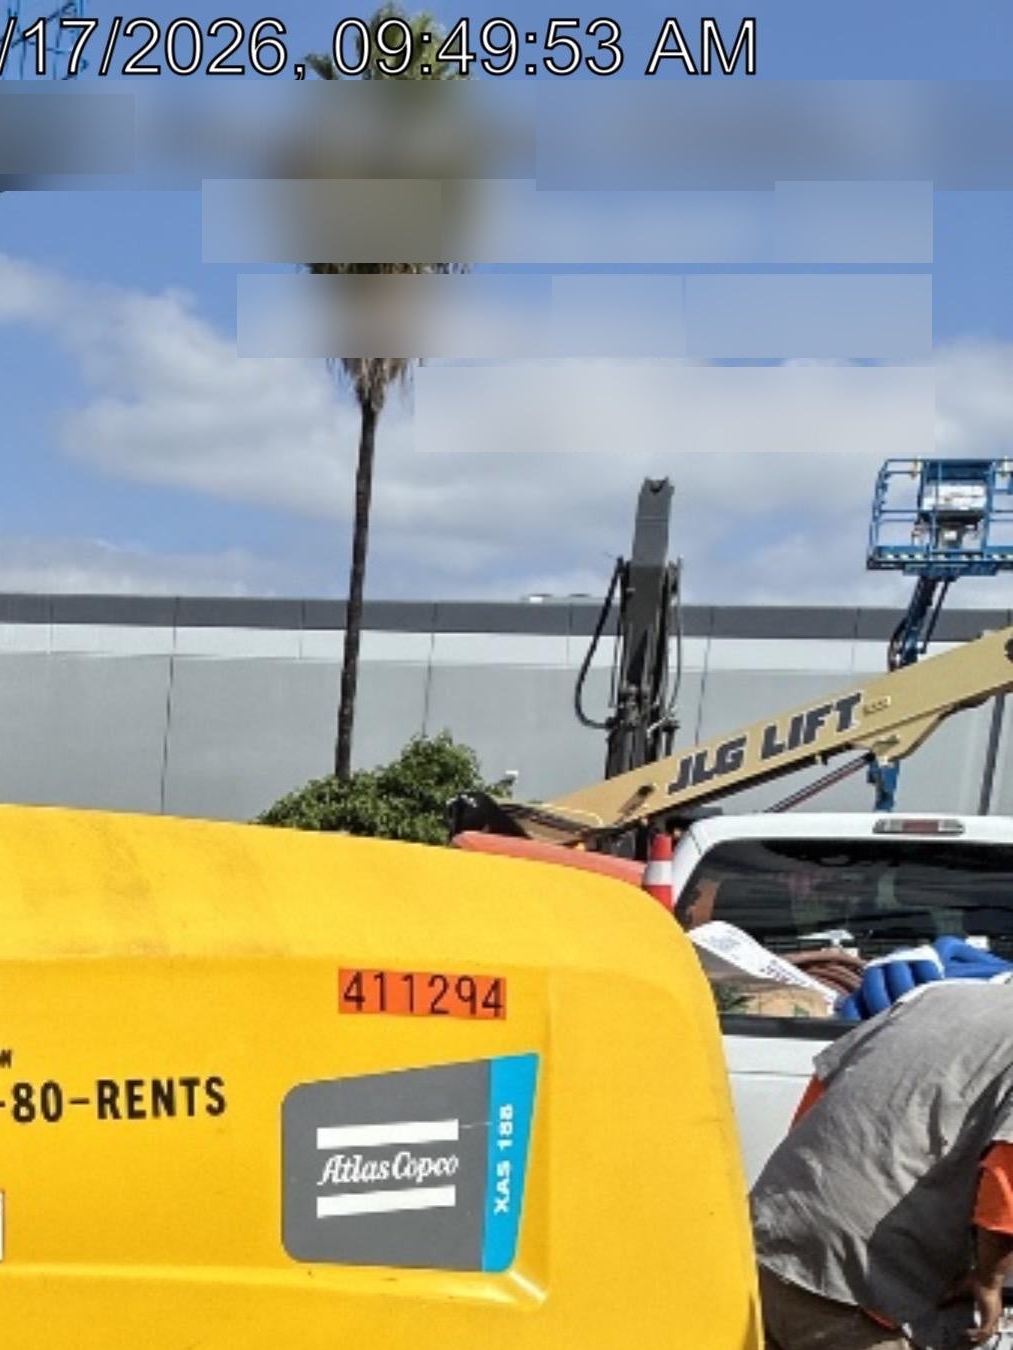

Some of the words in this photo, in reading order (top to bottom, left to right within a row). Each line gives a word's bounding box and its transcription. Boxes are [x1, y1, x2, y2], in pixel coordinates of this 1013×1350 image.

[668, 735, 748, 796] JLG
[759, 691, 861, 761] LIFT
[343, 971, 503, 1017] 411294
[493, 1160, 511, 1215] XAS
